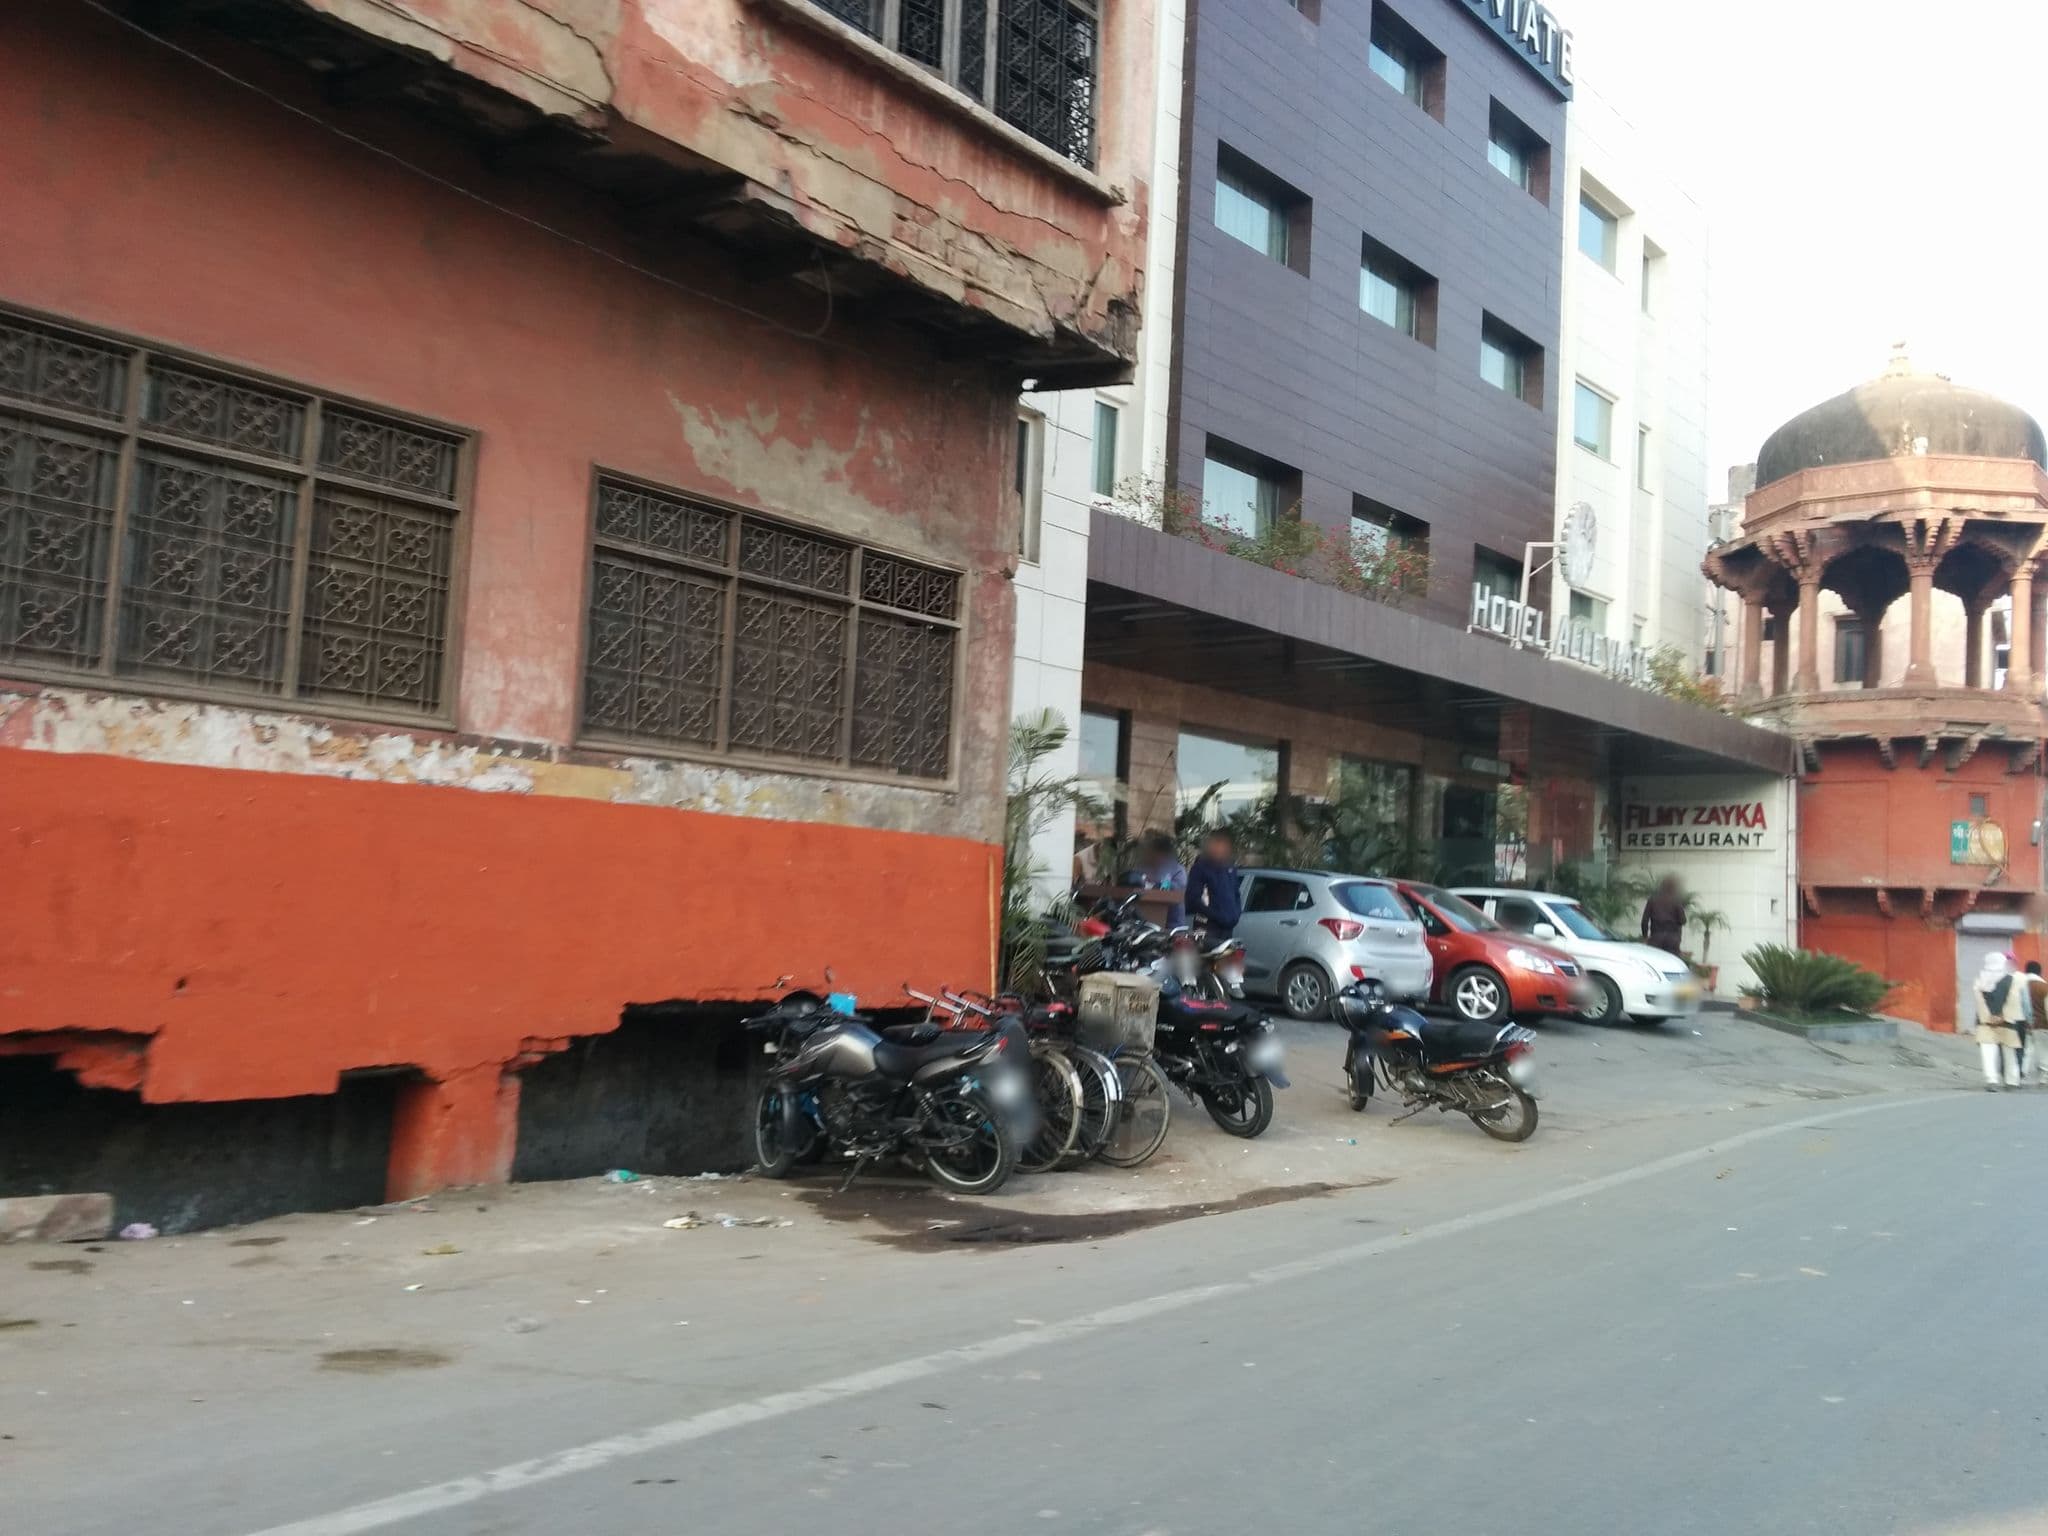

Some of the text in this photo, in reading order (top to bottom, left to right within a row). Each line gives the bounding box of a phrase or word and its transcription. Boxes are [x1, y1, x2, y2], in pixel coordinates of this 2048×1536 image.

[1472, 582, 1547, 646] HOTEL
[1625, 801, 1768, 830] FILMY ZAYKA
[1627, 832, 1764, 846] RESTAURANT
